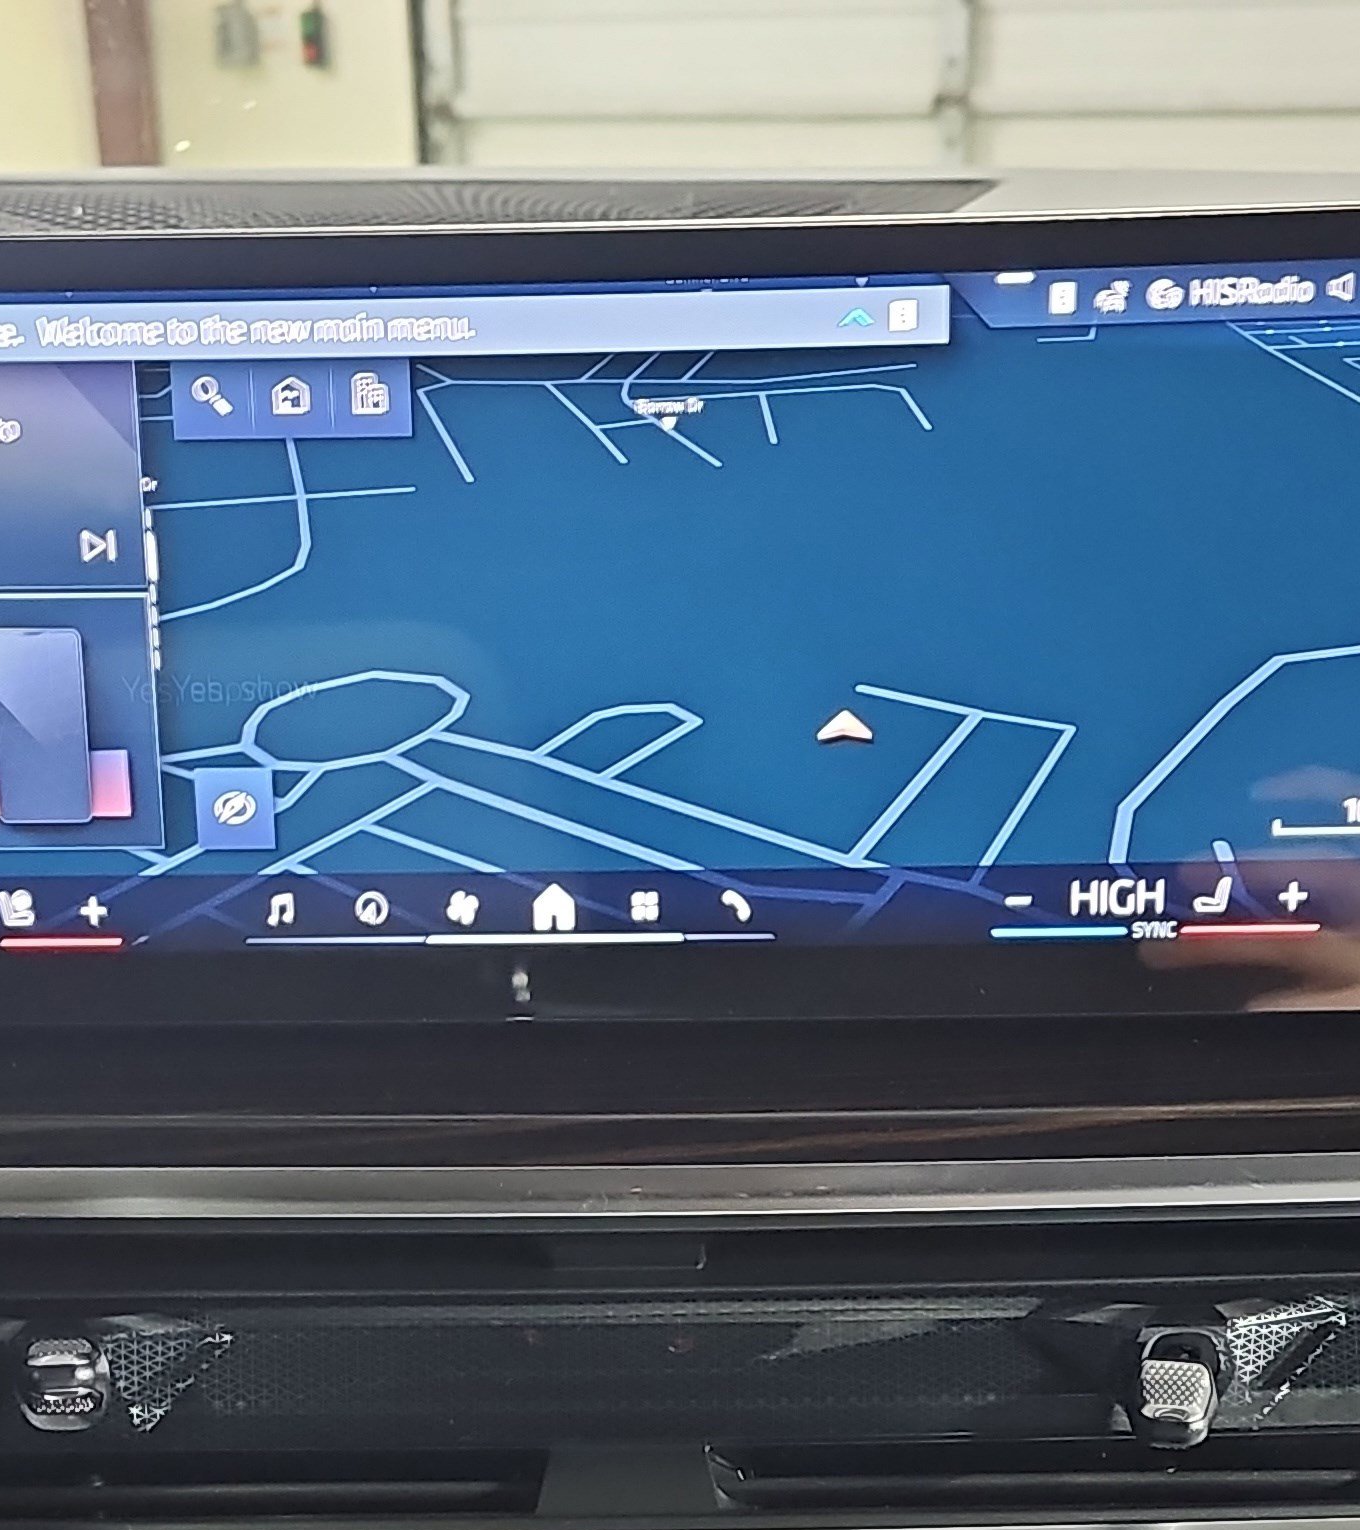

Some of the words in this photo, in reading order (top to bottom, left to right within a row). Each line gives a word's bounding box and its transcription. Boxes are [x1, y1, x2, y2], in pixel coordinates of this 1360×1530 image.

[1189, 275, 1316, 307] HISRadio
[35, 316, 164, 347] Welcome
[166, 317, 198, 346] to
[199, 313, 248, 346] the
[250, 319, 313, 345] new
[313, 312, 385, 343] main
[387, 315, 476, 342] menu.
[1069, 878, 1166, 917] HIGH
[1131, 921, 1178, 939] SYNC
